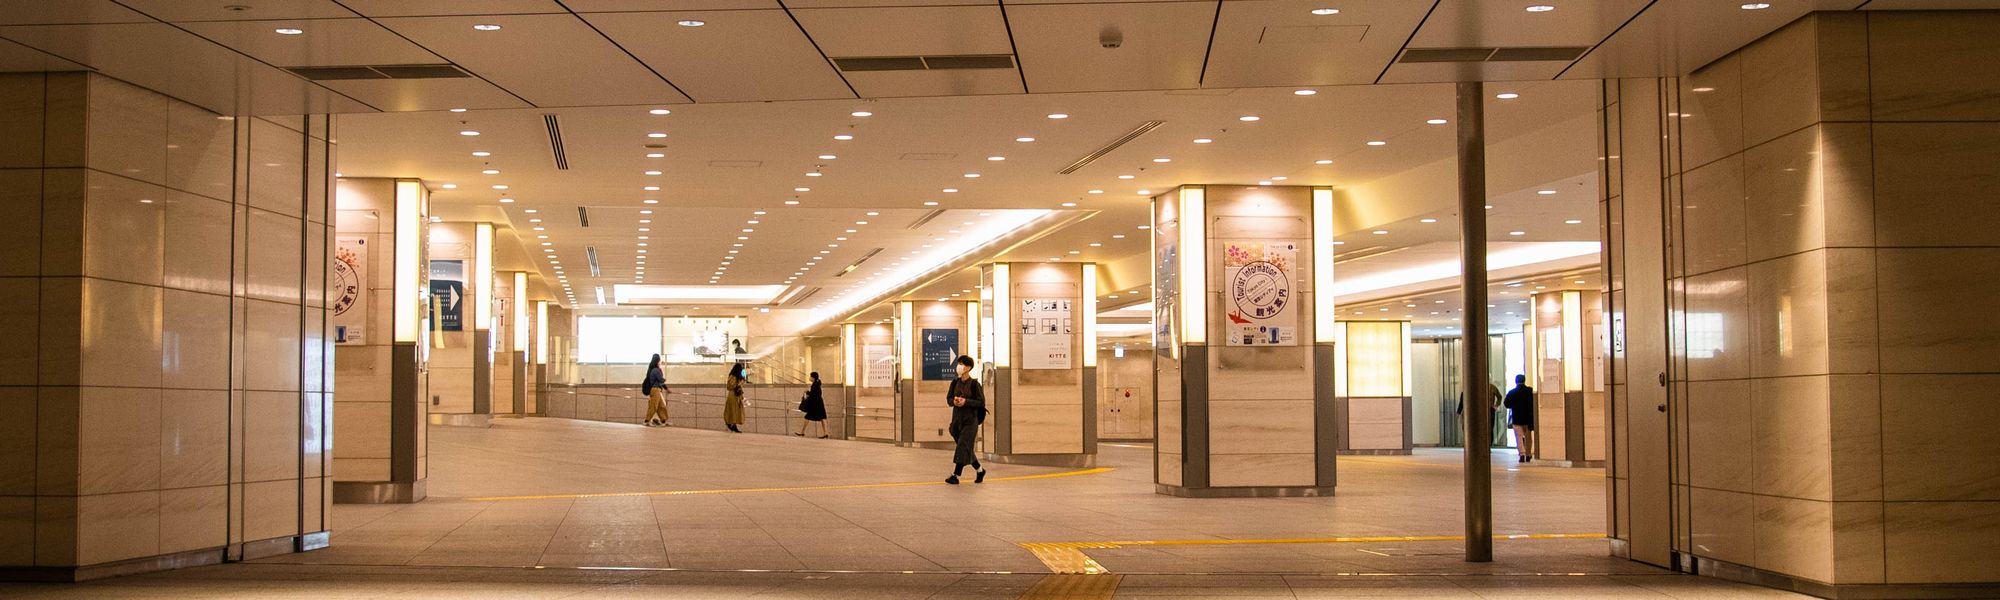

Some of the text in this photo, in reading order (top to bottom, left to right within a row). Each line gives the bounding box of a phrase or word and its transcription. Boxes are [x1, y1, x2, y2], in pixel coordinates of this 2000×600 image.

[1236, 265, 1277, 301] Tourist Information
[1256, 289, 1286, 317] 観光案内
